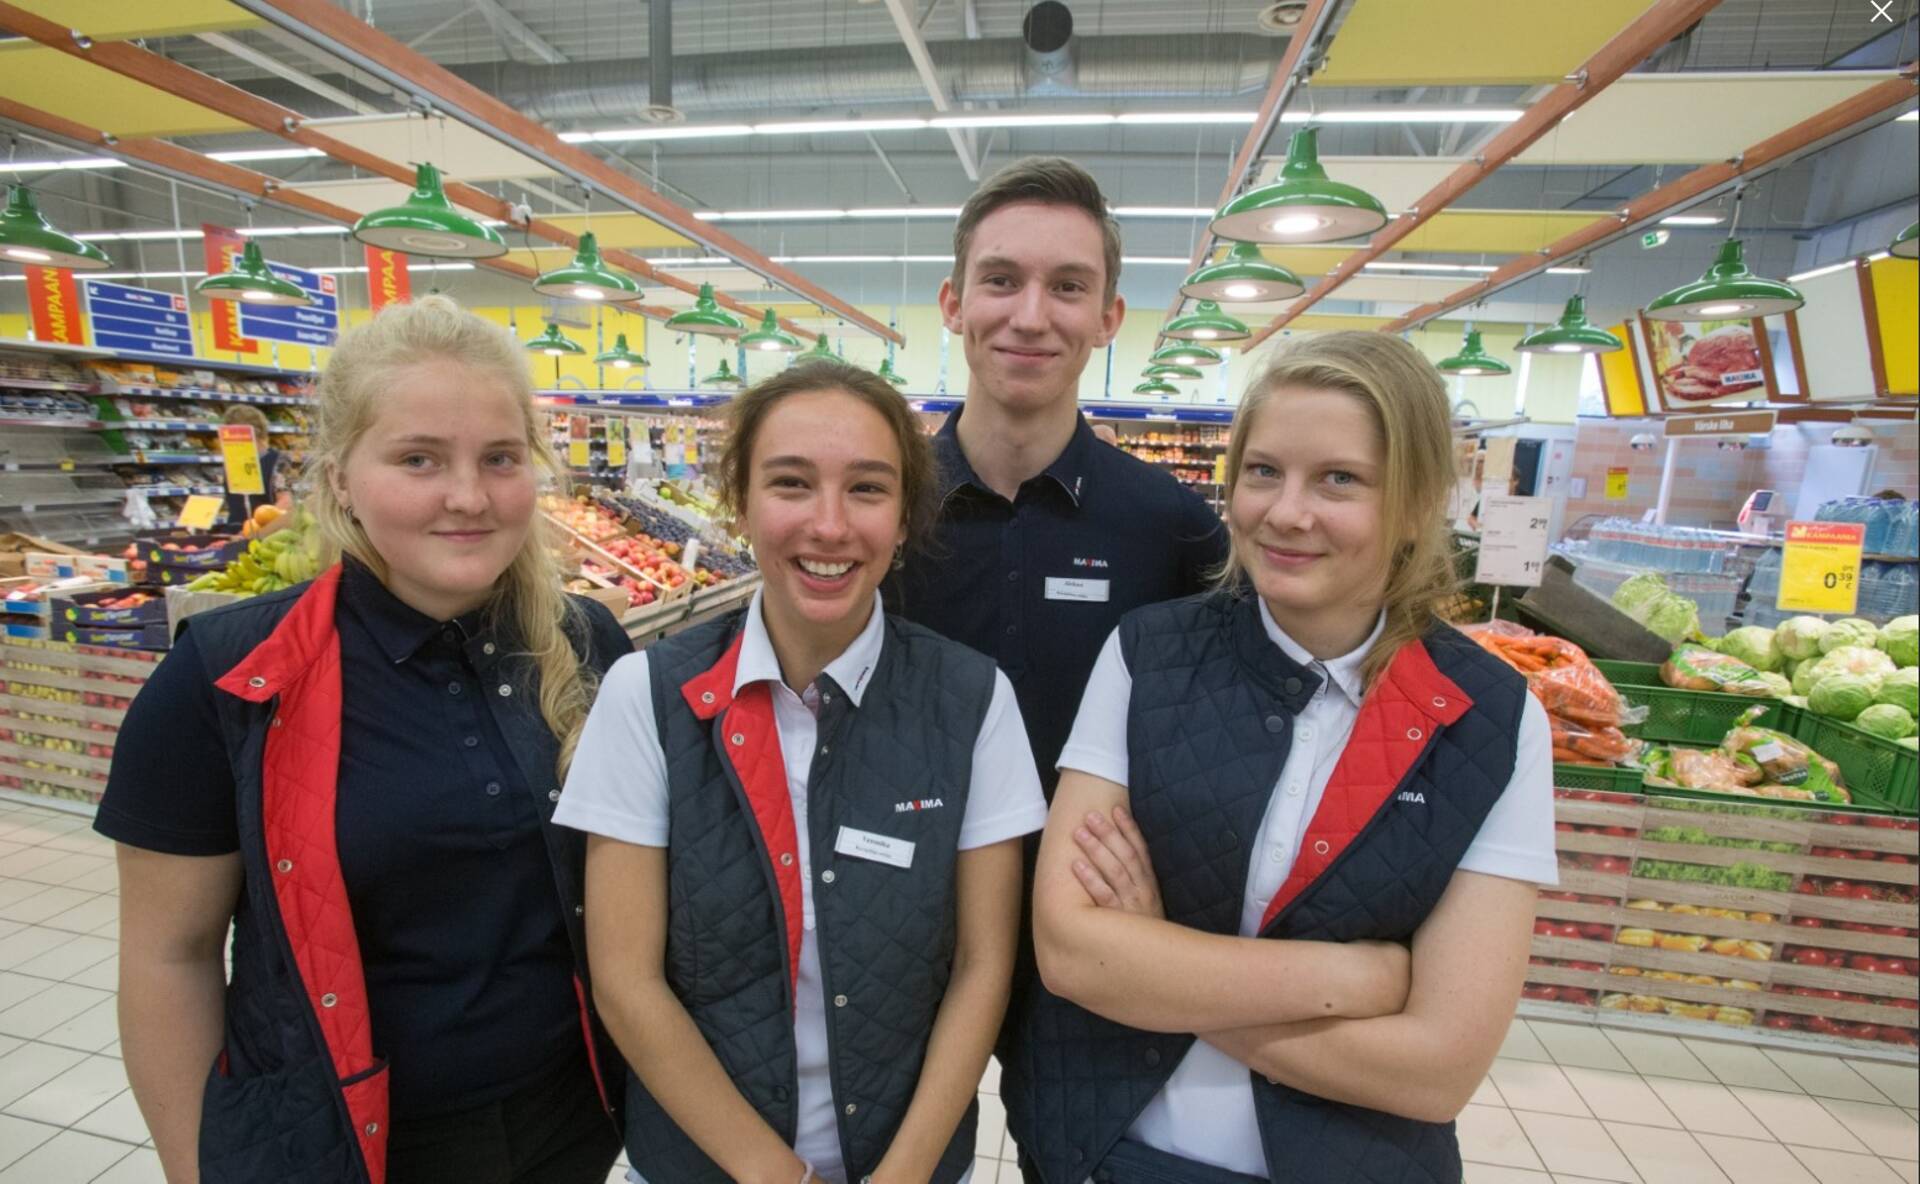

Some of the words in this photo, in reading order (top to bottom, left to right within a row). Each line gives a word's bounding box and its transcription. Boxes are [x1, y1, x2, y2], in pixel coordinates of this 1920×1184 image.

[1530, 517, 1539, 529] 2
[1073, 556, 1109, 569] MAXIMA
[1824, 572, 1837, 589] 0
[1838, 572, 1853, 582] 39
[894, 797, 944, 812] MAXIMA
